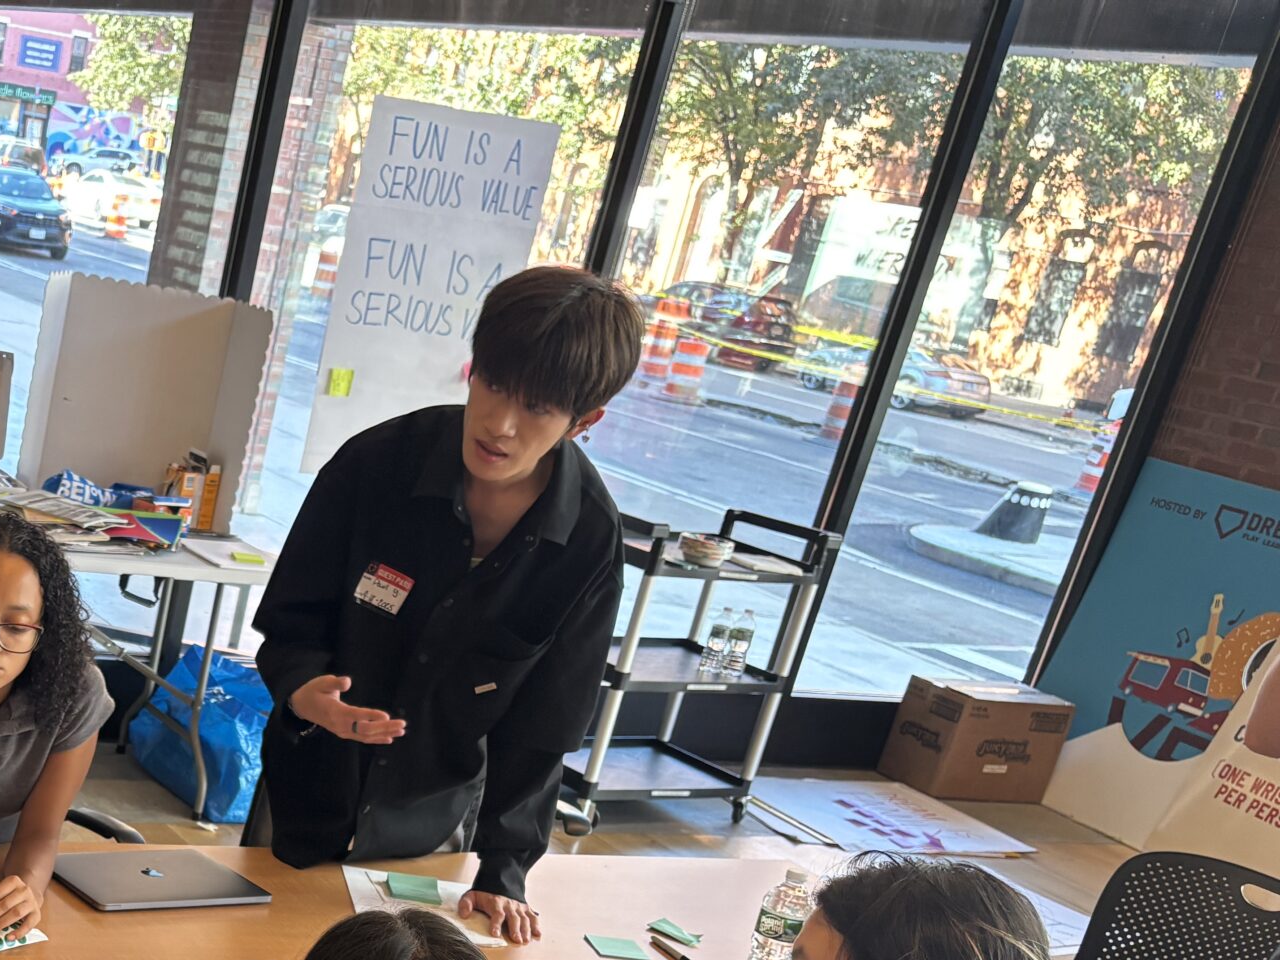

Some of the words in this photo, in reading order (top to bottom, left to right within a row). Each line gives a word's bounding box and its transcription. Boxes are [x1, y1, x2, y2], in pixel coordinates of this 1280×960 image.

[389, 115, 449, 162] FUN
[465, 130, 491, 166] IS
[503, 138, 521, 176] A
[372, 163, 464, 209] SERIOUS
[481, 179, 539, 221] VALUE
[365, 237, 428, 286] FUN
[446, 250, 475, 296] IS
[345, 289, 454, 337] SERIOUS
[1150, 496, 1192, 516] HOSTED
[1193, 509, 1208, 520] BY
[1214, 784, 1248, 810] PER
